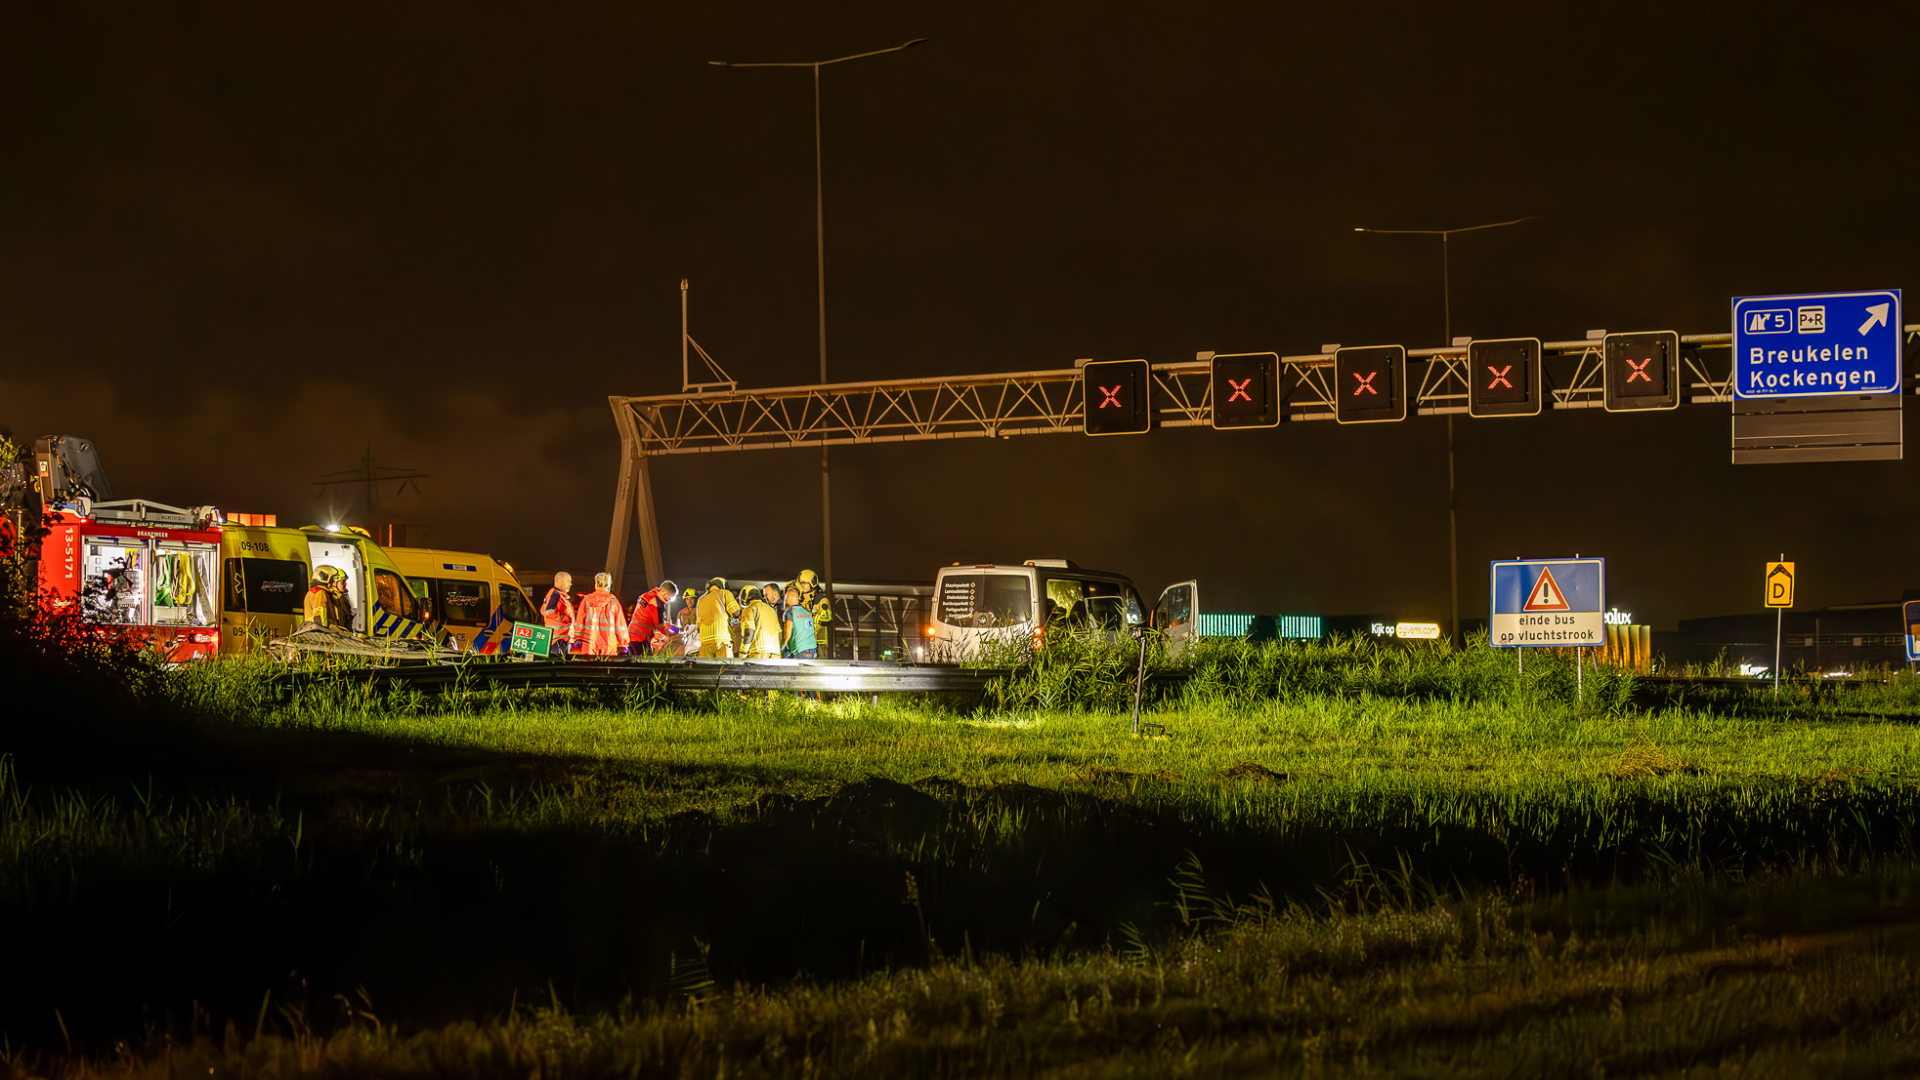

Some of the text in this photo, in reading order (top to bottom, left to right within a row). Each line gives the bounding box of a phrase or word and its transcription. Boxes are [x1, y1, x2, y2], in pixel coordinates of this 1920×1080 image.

[1774, 314, 1785, 328] 5
[1799, 313, 1823, 327] P+R
[1750, 343, 1868, 365] Breukelen
[1750, 369, 1876, 390] Kockengen
[64, 526, 74, 579] 13-5171
[241, 541, 270, 552] 09-108
[1773, 583, 1785, 599] D
[1519, 615, 1575, 625] einde bus
[518, 628, 530, 637] A2
[536, 631, 545, 640] Re
[1371, 622, 1385, 637] Kijk
[1385, 625, 1395, 637] op
[1501, 629, 1594, 642] op vluchtstrook
